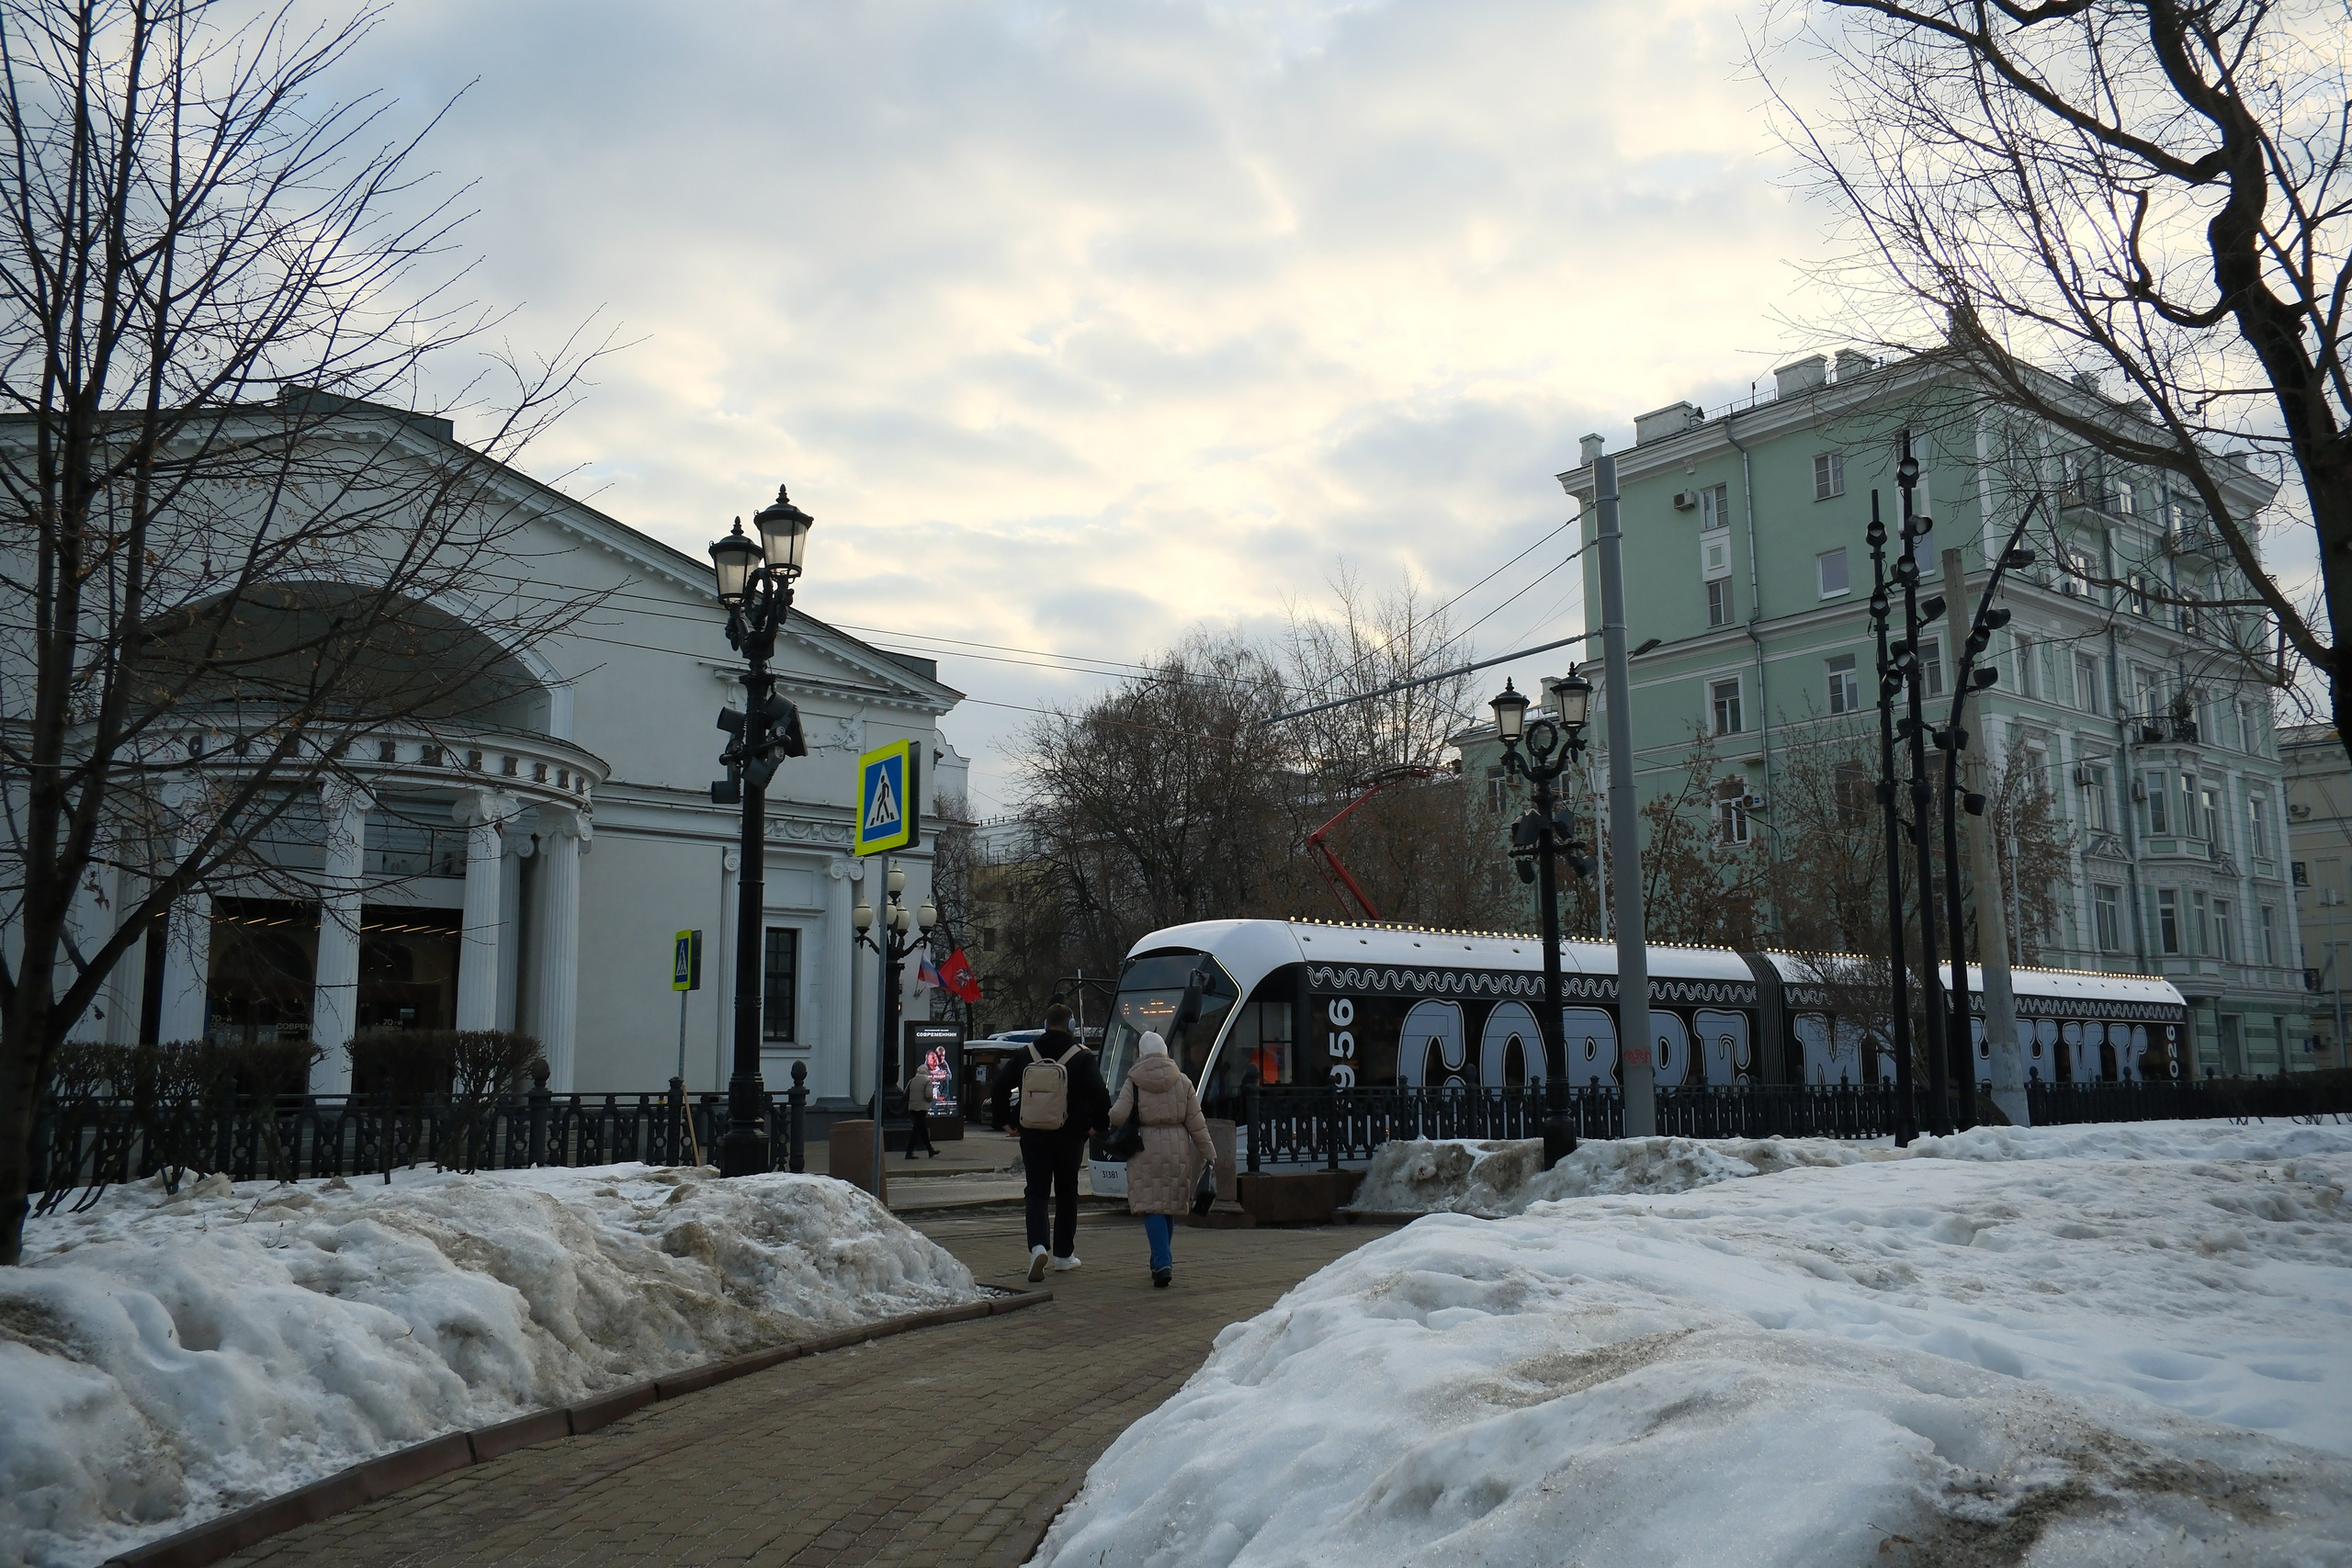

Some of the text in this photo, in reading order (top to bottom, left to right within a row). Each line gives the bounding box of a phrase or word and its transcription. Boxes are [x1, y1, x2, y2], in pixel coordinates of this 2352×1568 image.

[1328, 997, 1356, 1111] 956
[1396, 997, 2150, 1108] СОВЕМНИК
[2165, 1024, 2179, 1084] 026
[1102, 1170, 1119, 1179] 31381
